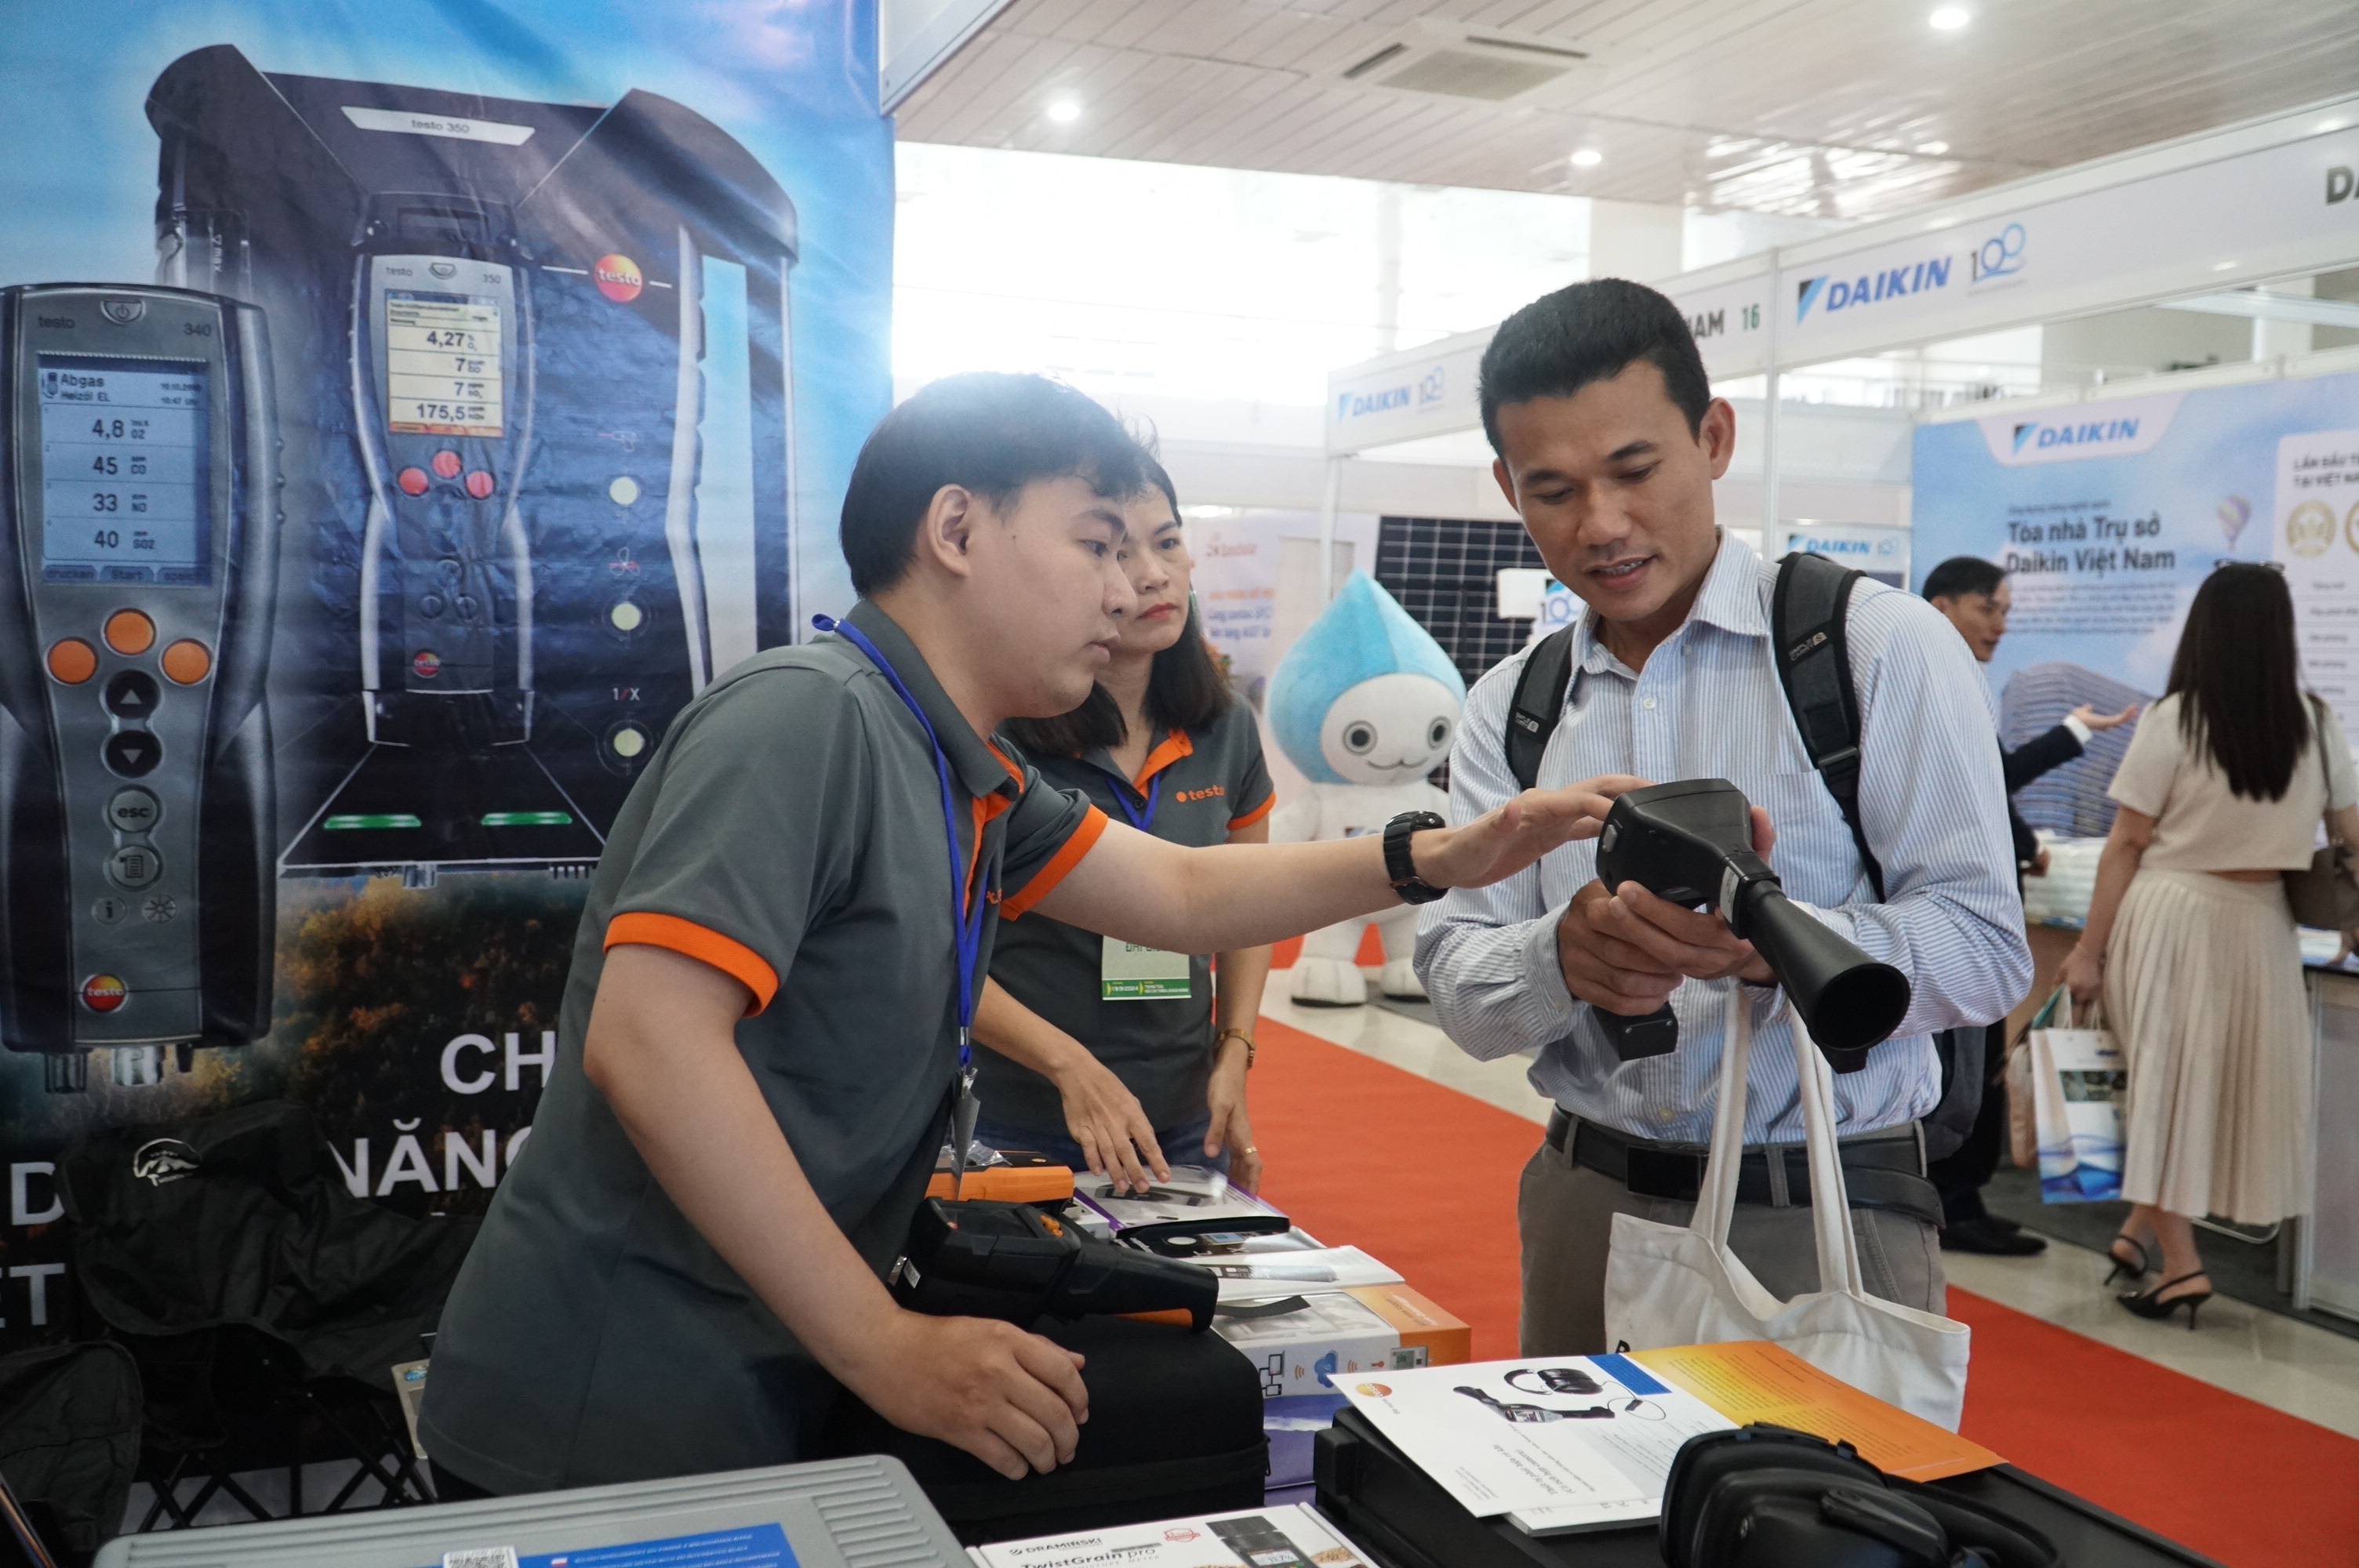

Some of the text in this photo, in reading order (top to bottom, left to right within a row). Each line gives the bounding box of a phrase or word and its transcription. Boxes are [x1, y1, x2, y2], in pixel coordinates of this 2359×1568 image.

[411, 119, 470, 134] testo 350
[2326, 165, 2359, 205] D
[385, 267, 413, 276] testo
[482, 274, 501, 284] 350
[598, 267, 642, 286] testo
[1826, 256, 1952, 311] DAIKIN
[38, 315, 75, 329] testo
[1742, 303, 1759, 329] 16
[184, 322, 211, 336] 340
[427, 331, 465, 348] 4,27
[456, 358, 466, 372] 7
[60, 373, 105, 388] Abgas
[454, 382, 464, 396] 7
[1352, 385, 1412, 417] DAIKIN
[416, 404, 465, 422] 175,5
[93, 419, 124, 440] 4,8
[2038, 419, 2139, 448] DAIKIN
[93, 456, 118, 475] 45
[93, 493, 118, 511] 33
[2008, 519, 2043, 543] Tòa
[2048, 517, 2086, 540] nhà
[2094, 515, 2128, 545] Trụ
[95, 531, 118, 549] 40
[1807, 537, 1872, 554] DAIKIN
[2007, 548, 2175, 579] Daikin Việt Nam
[1188, 786, 1225, 800] testo
[117, 805, 150, 818] esc
[87, 987, 124, 996] testo
[328, 1118, 533, 1200] NĂN
[0, 1263, 65, 1329] T
[1127, 1548, 1156, 1559] pro
